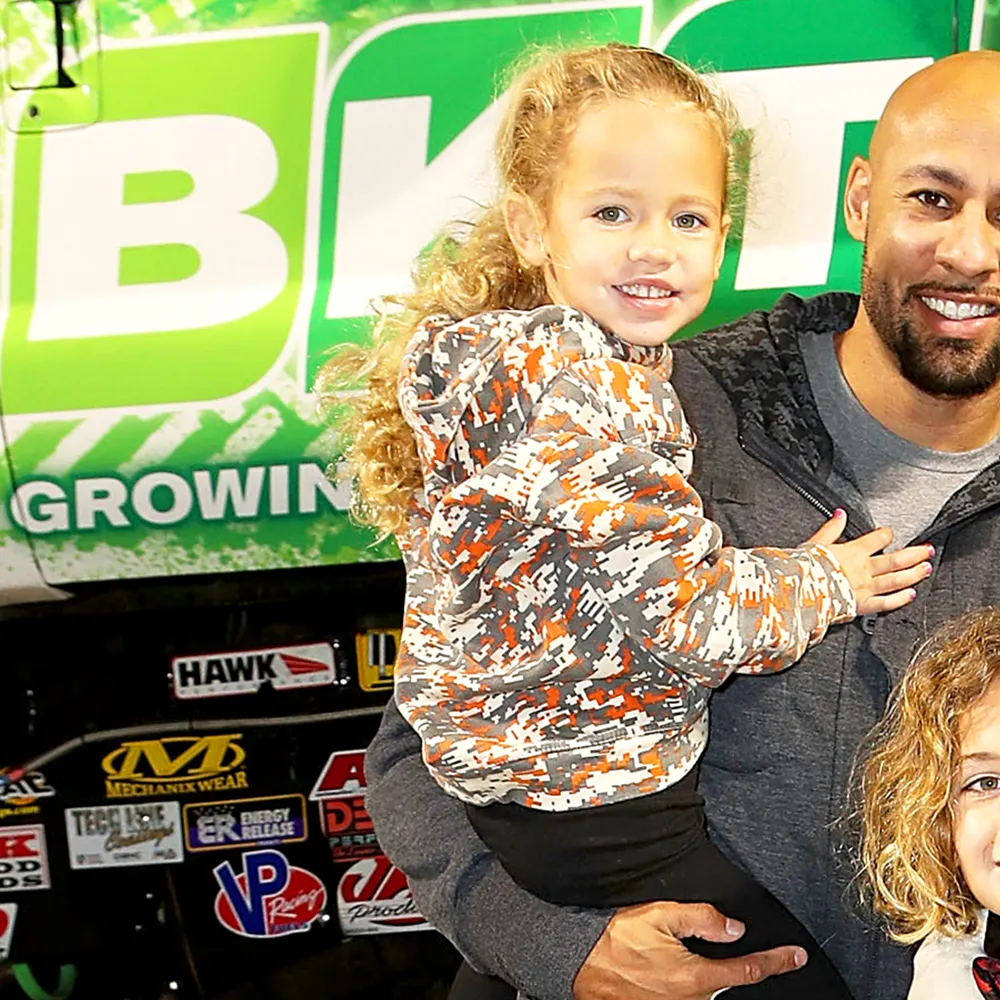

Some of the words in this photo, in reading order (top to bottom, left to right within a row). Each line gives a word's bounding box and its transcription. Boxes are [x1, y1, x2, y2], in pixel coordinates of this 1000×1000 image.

[179, 653, 278, 687] HAWK
[105, 780, 198, 799] MECHANIX
[199, 771, 249, 793] WEAR
[240, 808, 291, 827] ENERGY
[240, 821, 296, 839] RELEASE
[213, 849, 290, 938] VP
[267, 887, 324, 924] Racing
